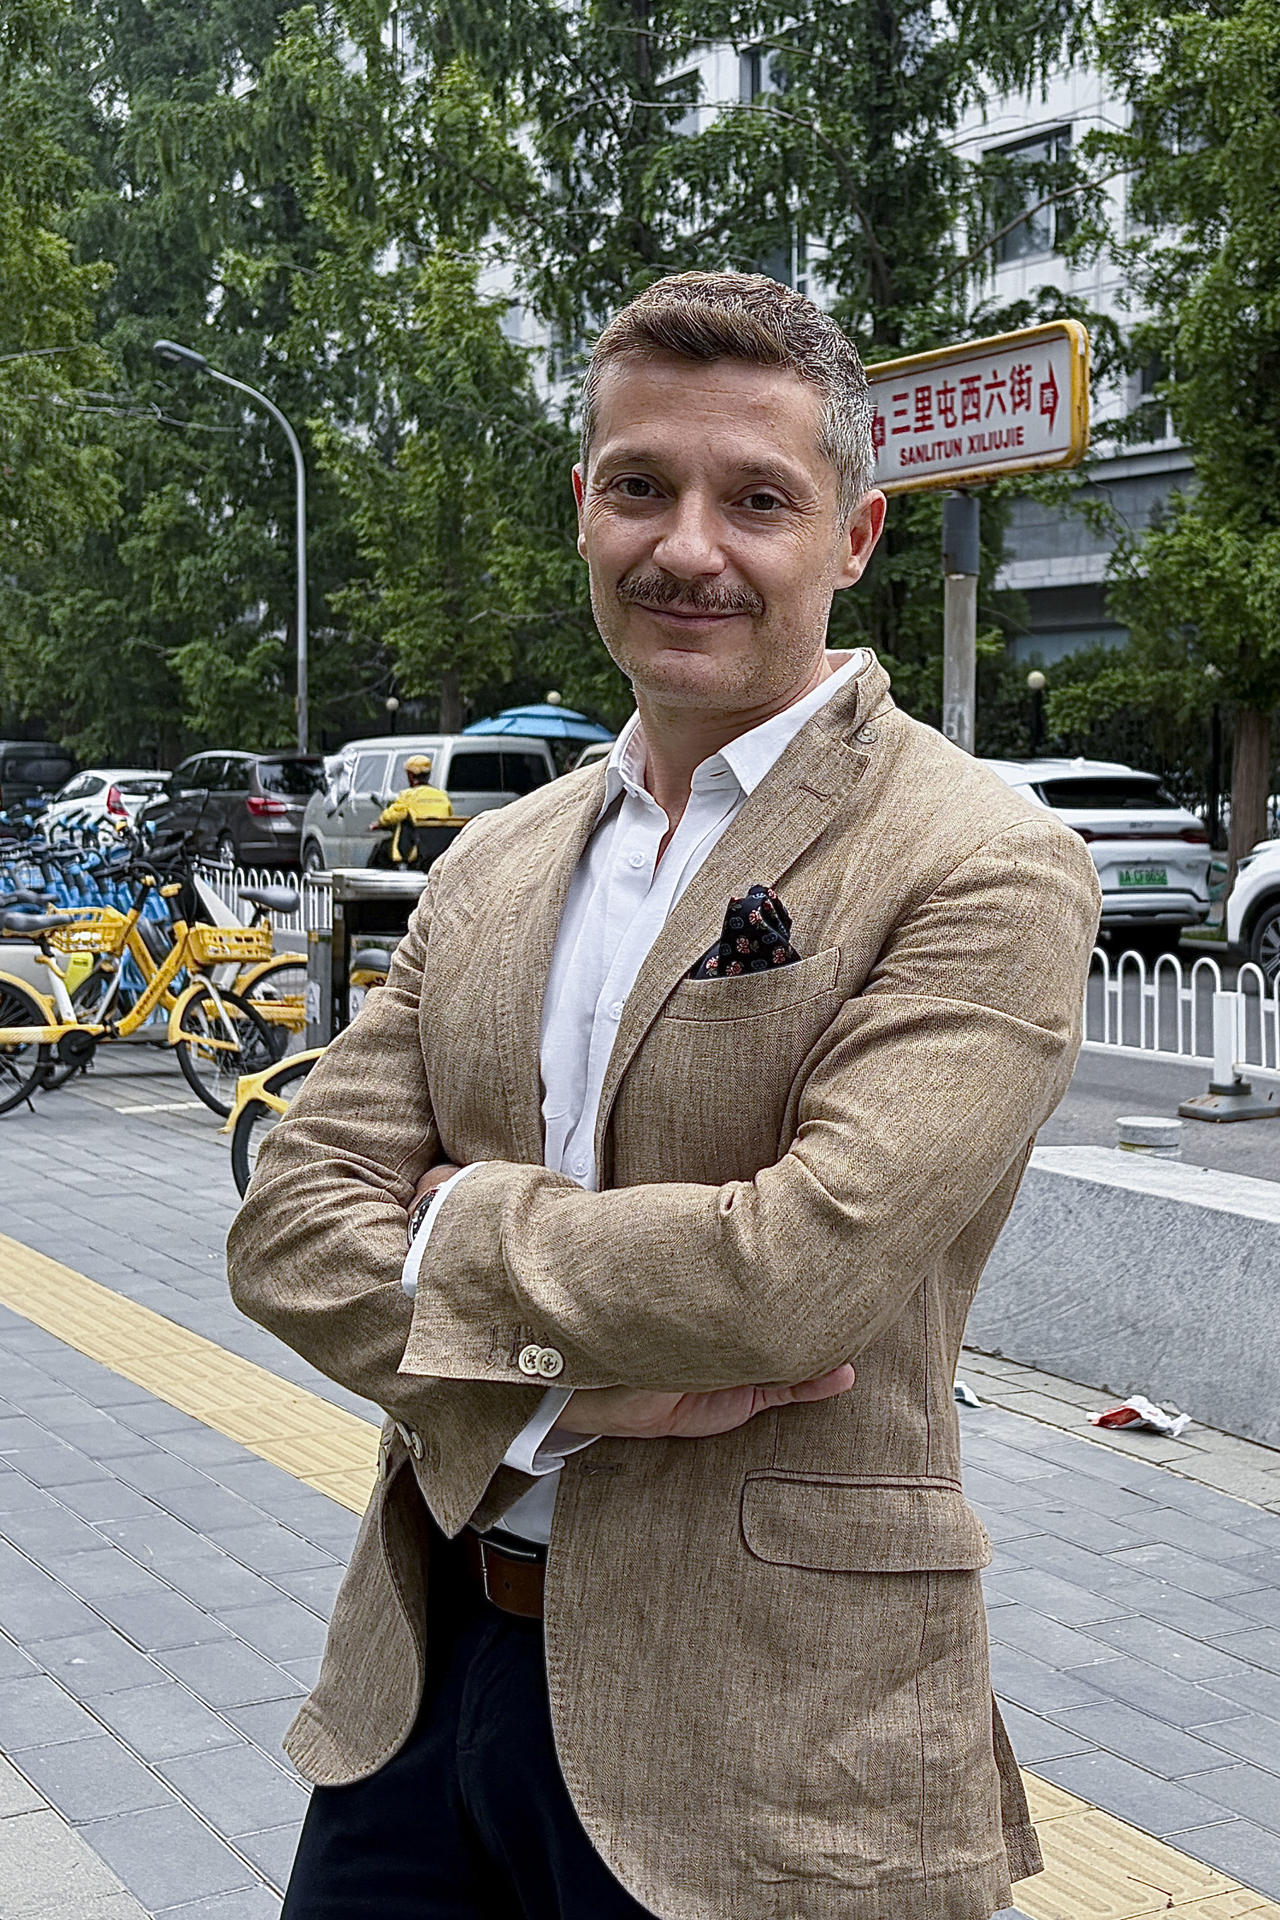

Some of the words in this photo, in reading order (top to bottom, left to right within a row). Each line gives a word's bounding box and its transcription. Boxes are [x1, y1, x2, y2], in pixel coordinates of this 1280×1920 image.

[891, 364, 1032, 435] 三里屯西六街
[900, 438, 962, 466] SANLITUN
[967, 426, 1024, 454] XILIUJIE
